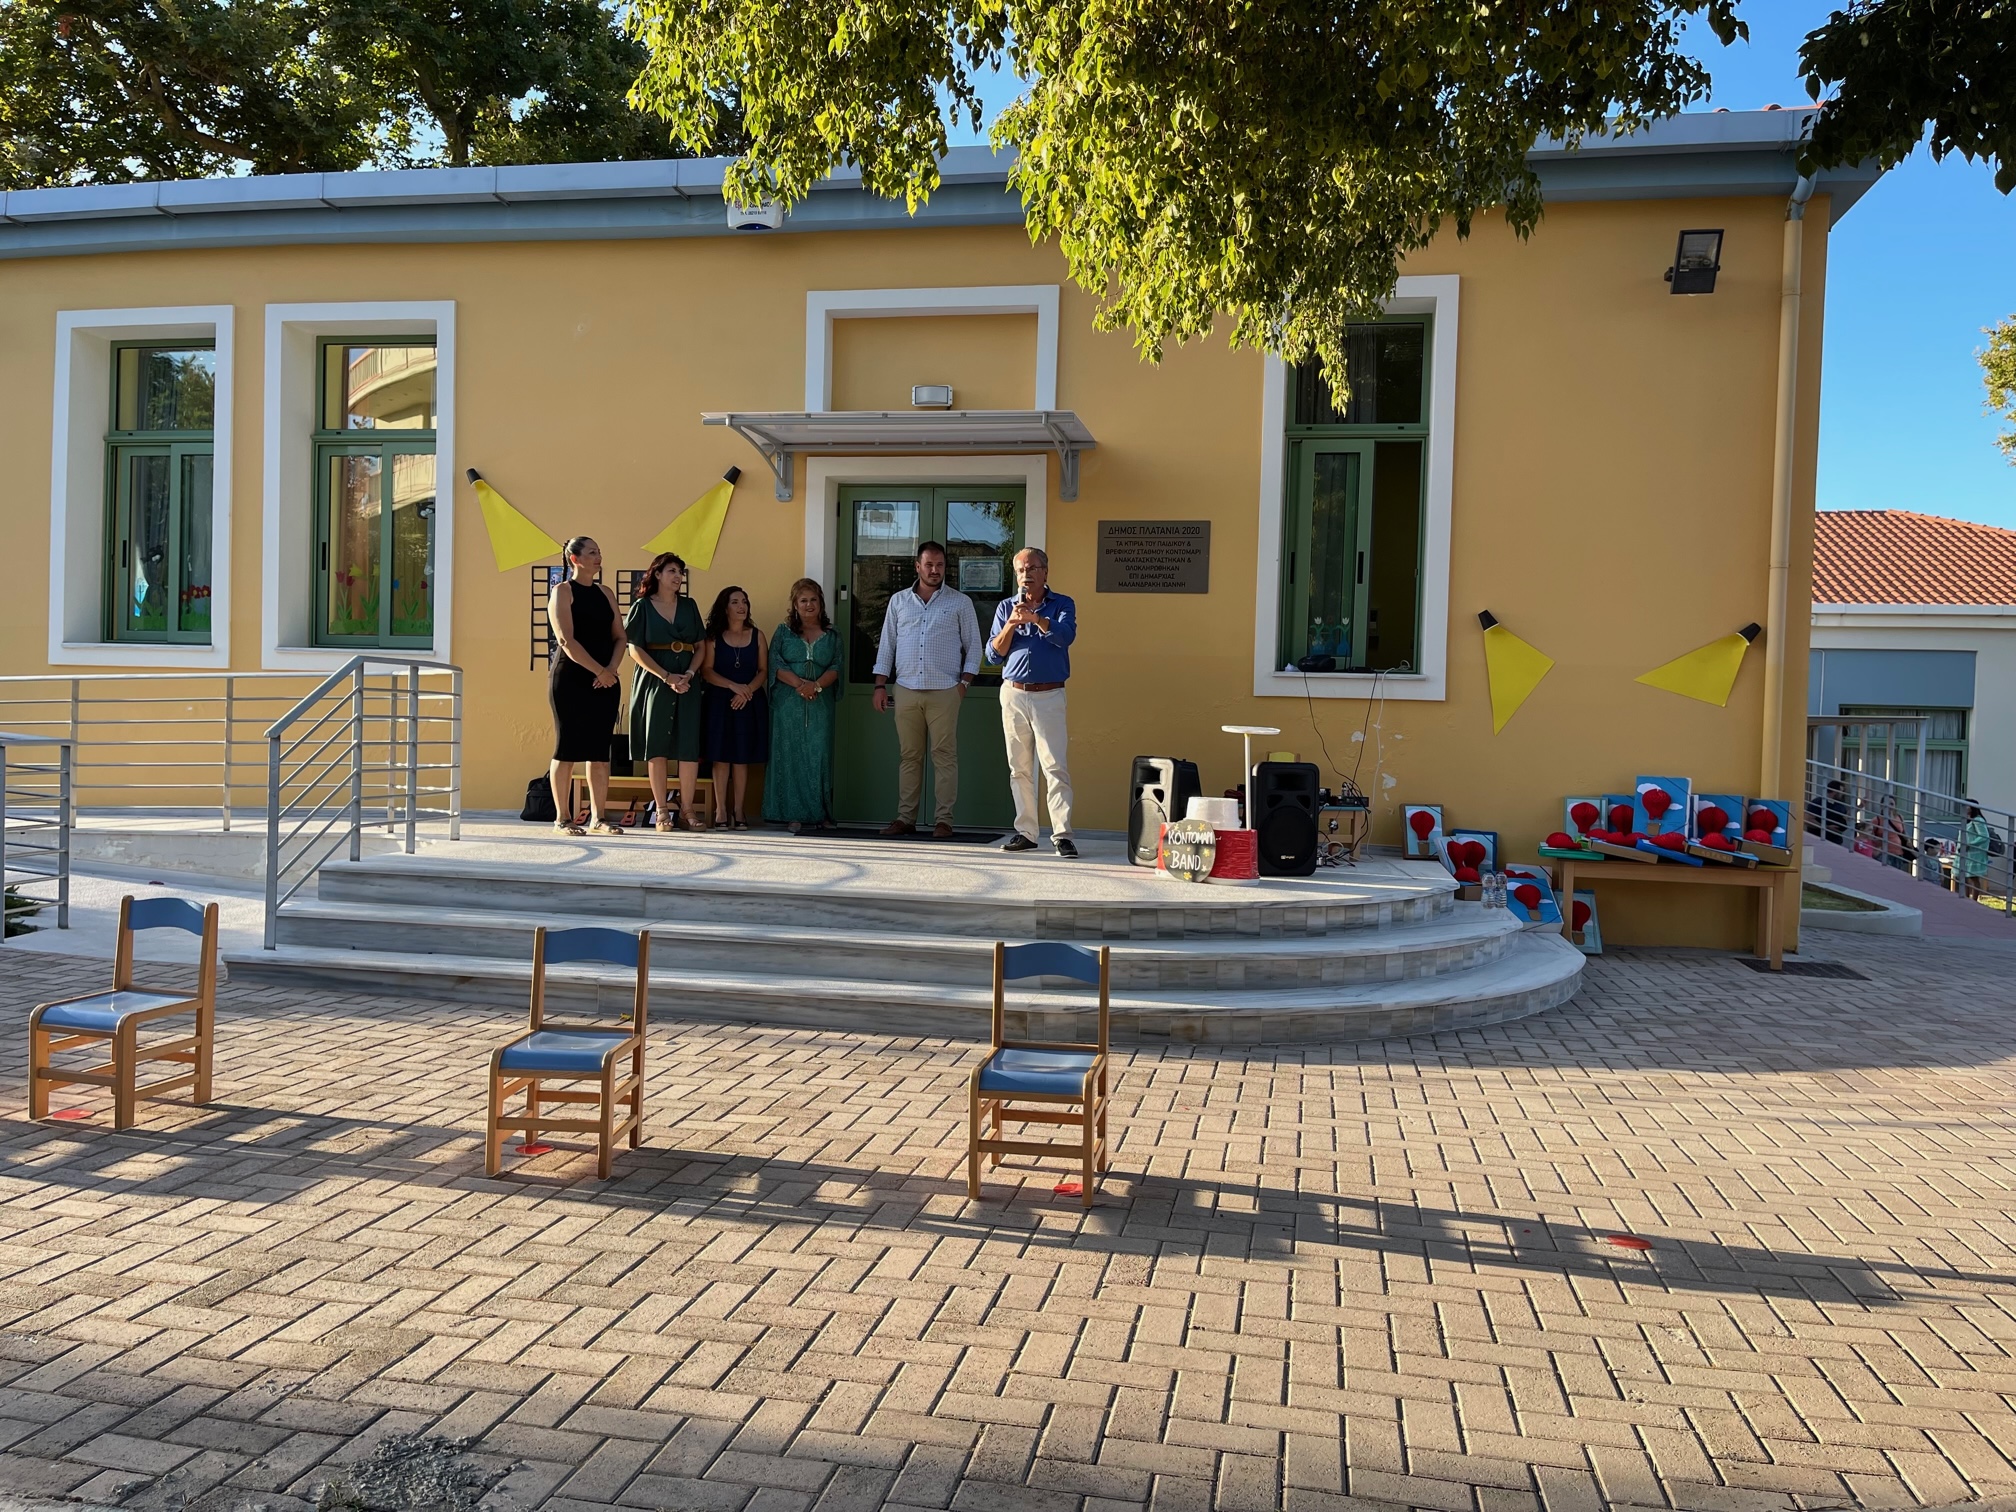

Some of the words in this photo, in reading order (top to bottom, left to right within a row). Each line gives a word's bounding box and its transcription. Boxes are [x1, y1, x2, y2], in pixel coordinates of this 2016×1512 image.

[1108, 526, 1137, 535] ΔΗΜΟΣ
[1139, 526, 1180, 535] ΠΛΑΤΑΝΙΑ
[1182, 526, 1200, 535] 2020
[1170, 850, 1201, 871] BAND
